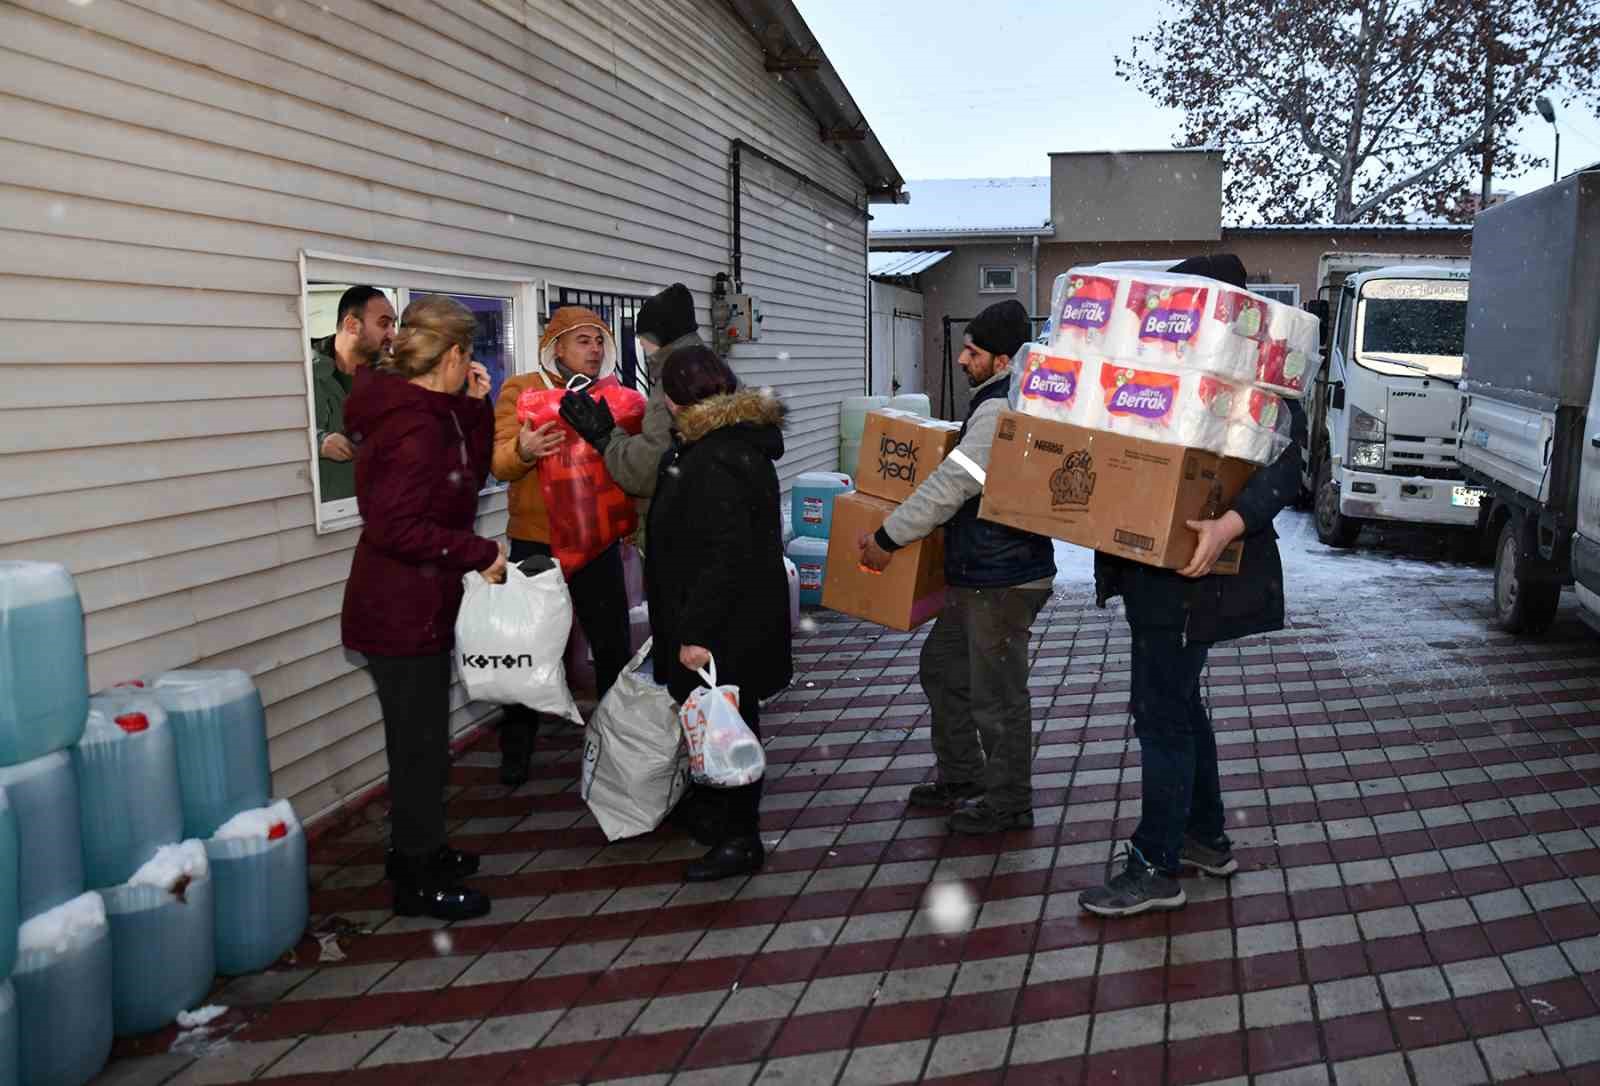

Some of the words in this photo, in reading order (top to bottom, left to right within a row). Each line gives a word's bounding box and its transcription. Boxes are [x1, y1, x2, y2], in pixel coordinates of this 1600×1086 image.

[1063, 304, 1106, 323] Berrak
[1145, 316, 1194, 334] Berrak
[1030, 376, 1071, 395] Berrak
[1116, 393, 1168, 411] Berrak
[880, 432, 920, 462] ipek
